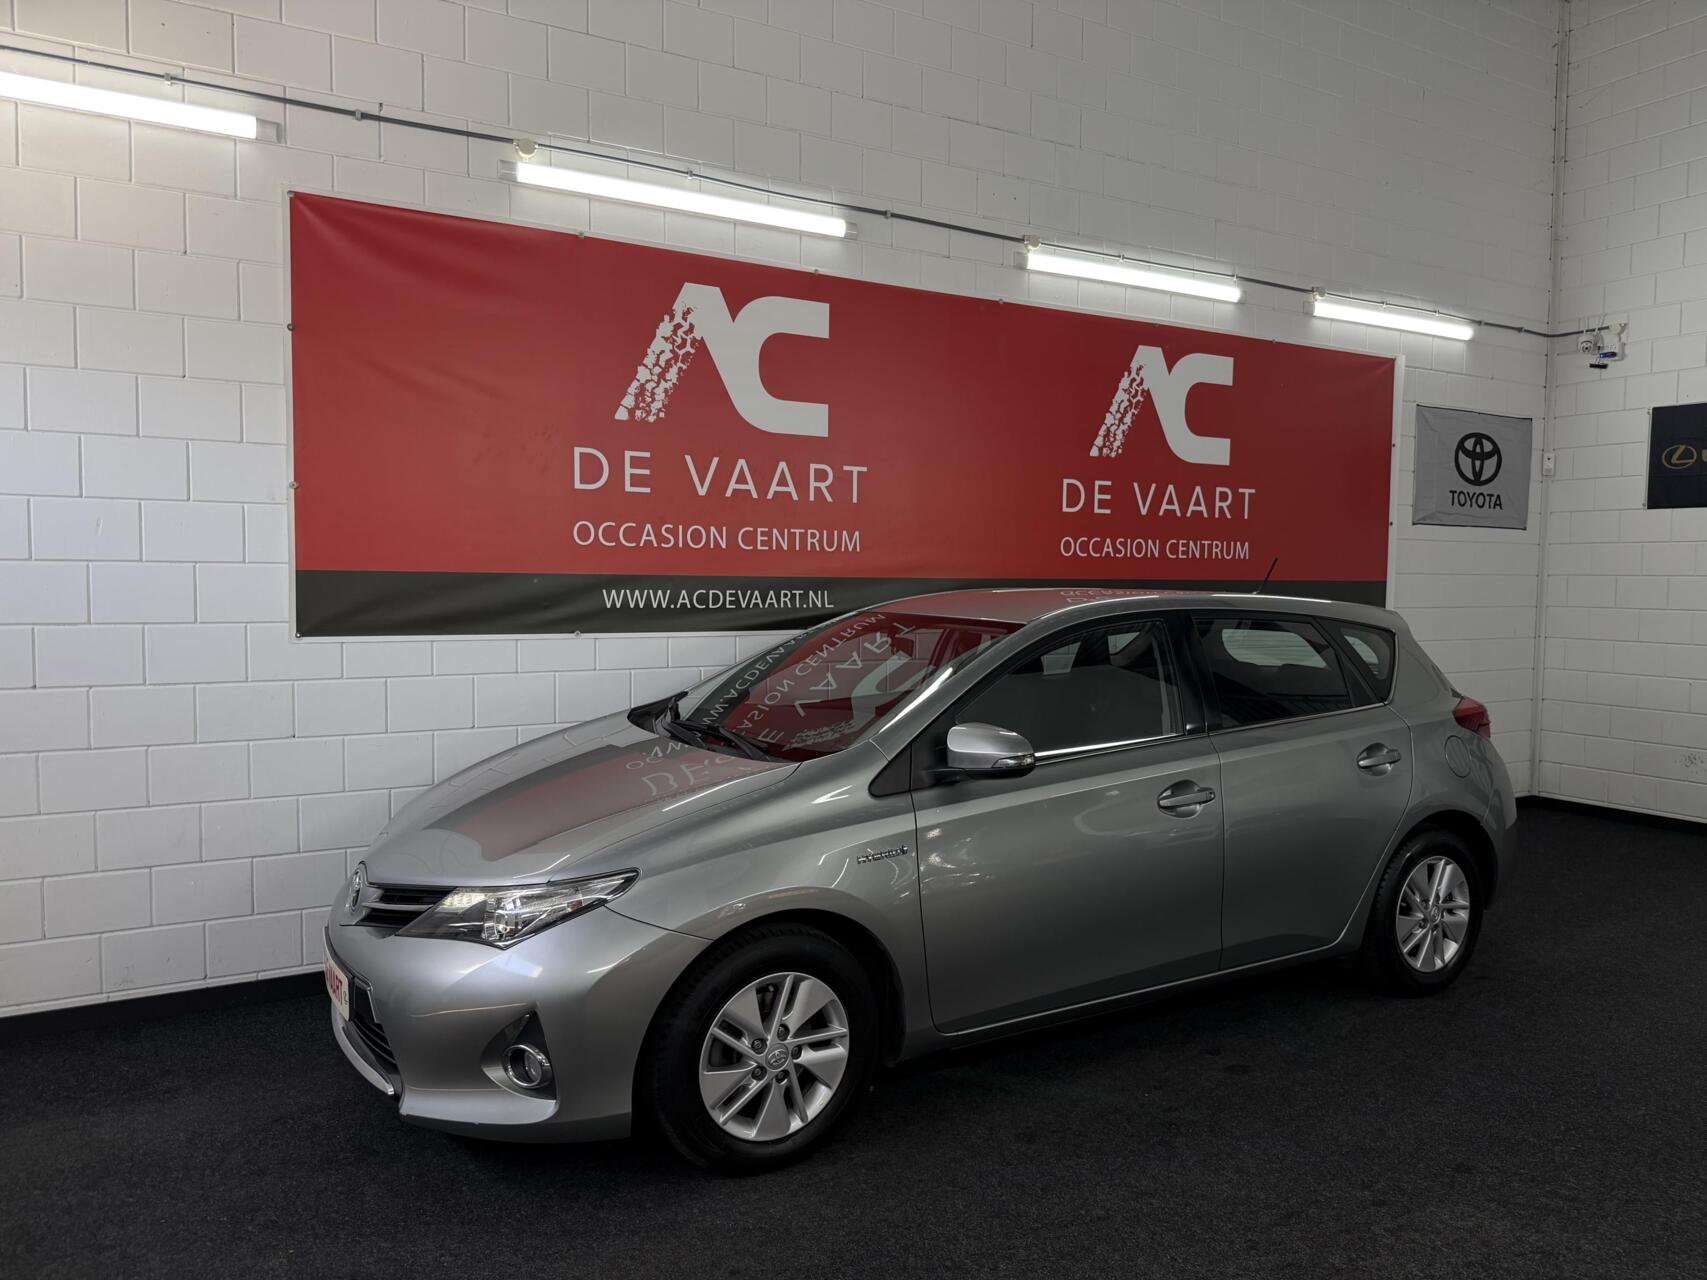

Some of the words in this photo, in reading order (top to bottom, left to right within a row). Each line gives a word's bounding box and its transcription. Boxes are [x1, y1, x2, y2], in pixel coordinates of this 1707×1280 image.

[573, 446, 651, 493] DE
[684, 454, 868, 504] VAART
[1061, 478, 1112, 514] DE
[1132, 482, 1256, 520] VAART
[1448, 489, 1503, 510] TOYOTA
[572, 520, 727, 549] OCCASION
[737, 526, 861, 552] CENTRUM
[1060, 536, 1159, 558] OCCASION
[1166, 539, 1249, 560] CENTRUM
[602, 588, 835, 609] WWW.ACDEVAART.NL
